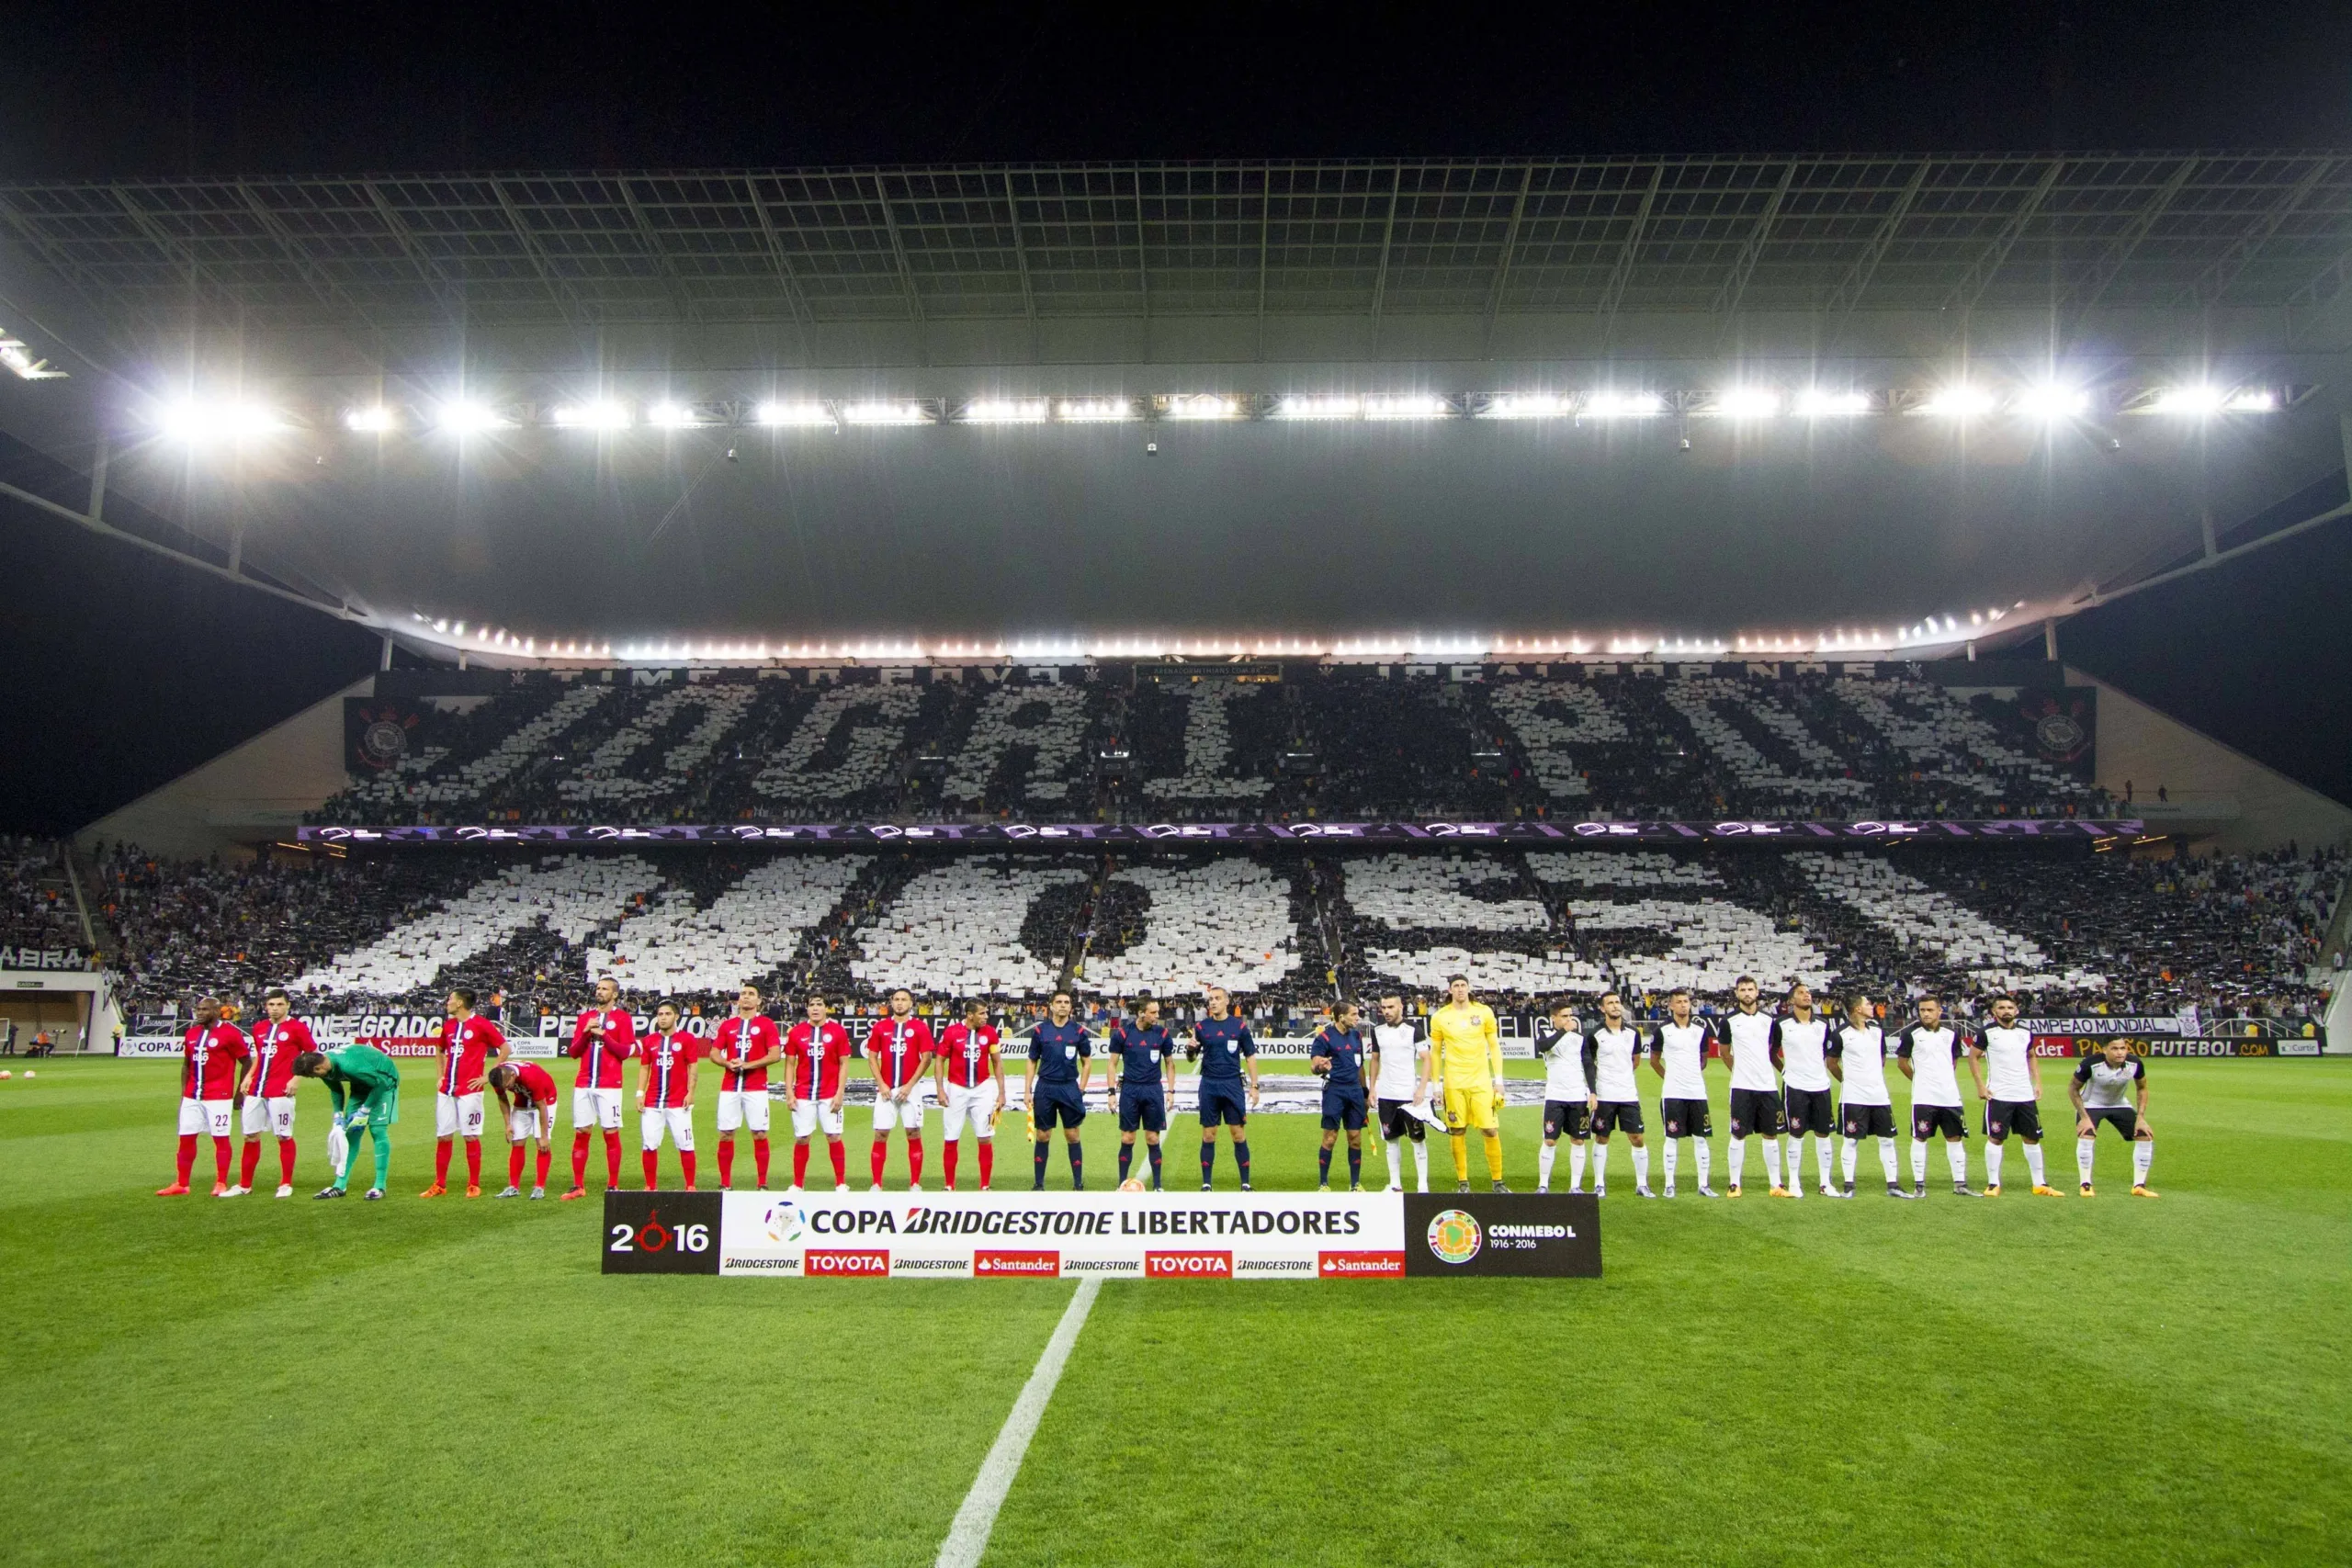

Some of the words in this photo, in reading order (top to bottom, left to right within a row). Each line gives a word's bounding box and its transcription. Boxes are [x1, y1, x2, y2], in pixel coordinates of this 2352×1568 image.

[2097, 1019, 2165, 1032] MUNDIAL
[138, 1043, 172, 1053] COPA
[380, 1040, 436, 1057] Santan
[215, 1114, 229, 1126] 22
[278, 1113, 289, 1125] 18
[468, 1112, 481, 1125] 20
[1579, 1117, 1590, 1130] 23
[810, 1209, 897, 1235] COPA
[903, 1208, 1114, 1235] BRIDGESTONE
[1122, 1210, 1361, 1235] LIBERTADORES
[1487, 1224, 1577, 1238] CONMEBOL
[725, 1258, 799, 1269] BRIDGESTONE
[809, 1256, 885, 1271] TOYOTA
[894, 1258, 969, 1270] BRIDGESTONE
[992, 1258, 1055, 1271] Santander
[1064, 1258, 1139, 1271] BRIDGESTONE
[1150, 1257, 1227, 1272] TOYOTA
[1237, 1259, 1313, 1271] BRIDGESTONE
[1338, 1258, 1400, 1272] Santander
